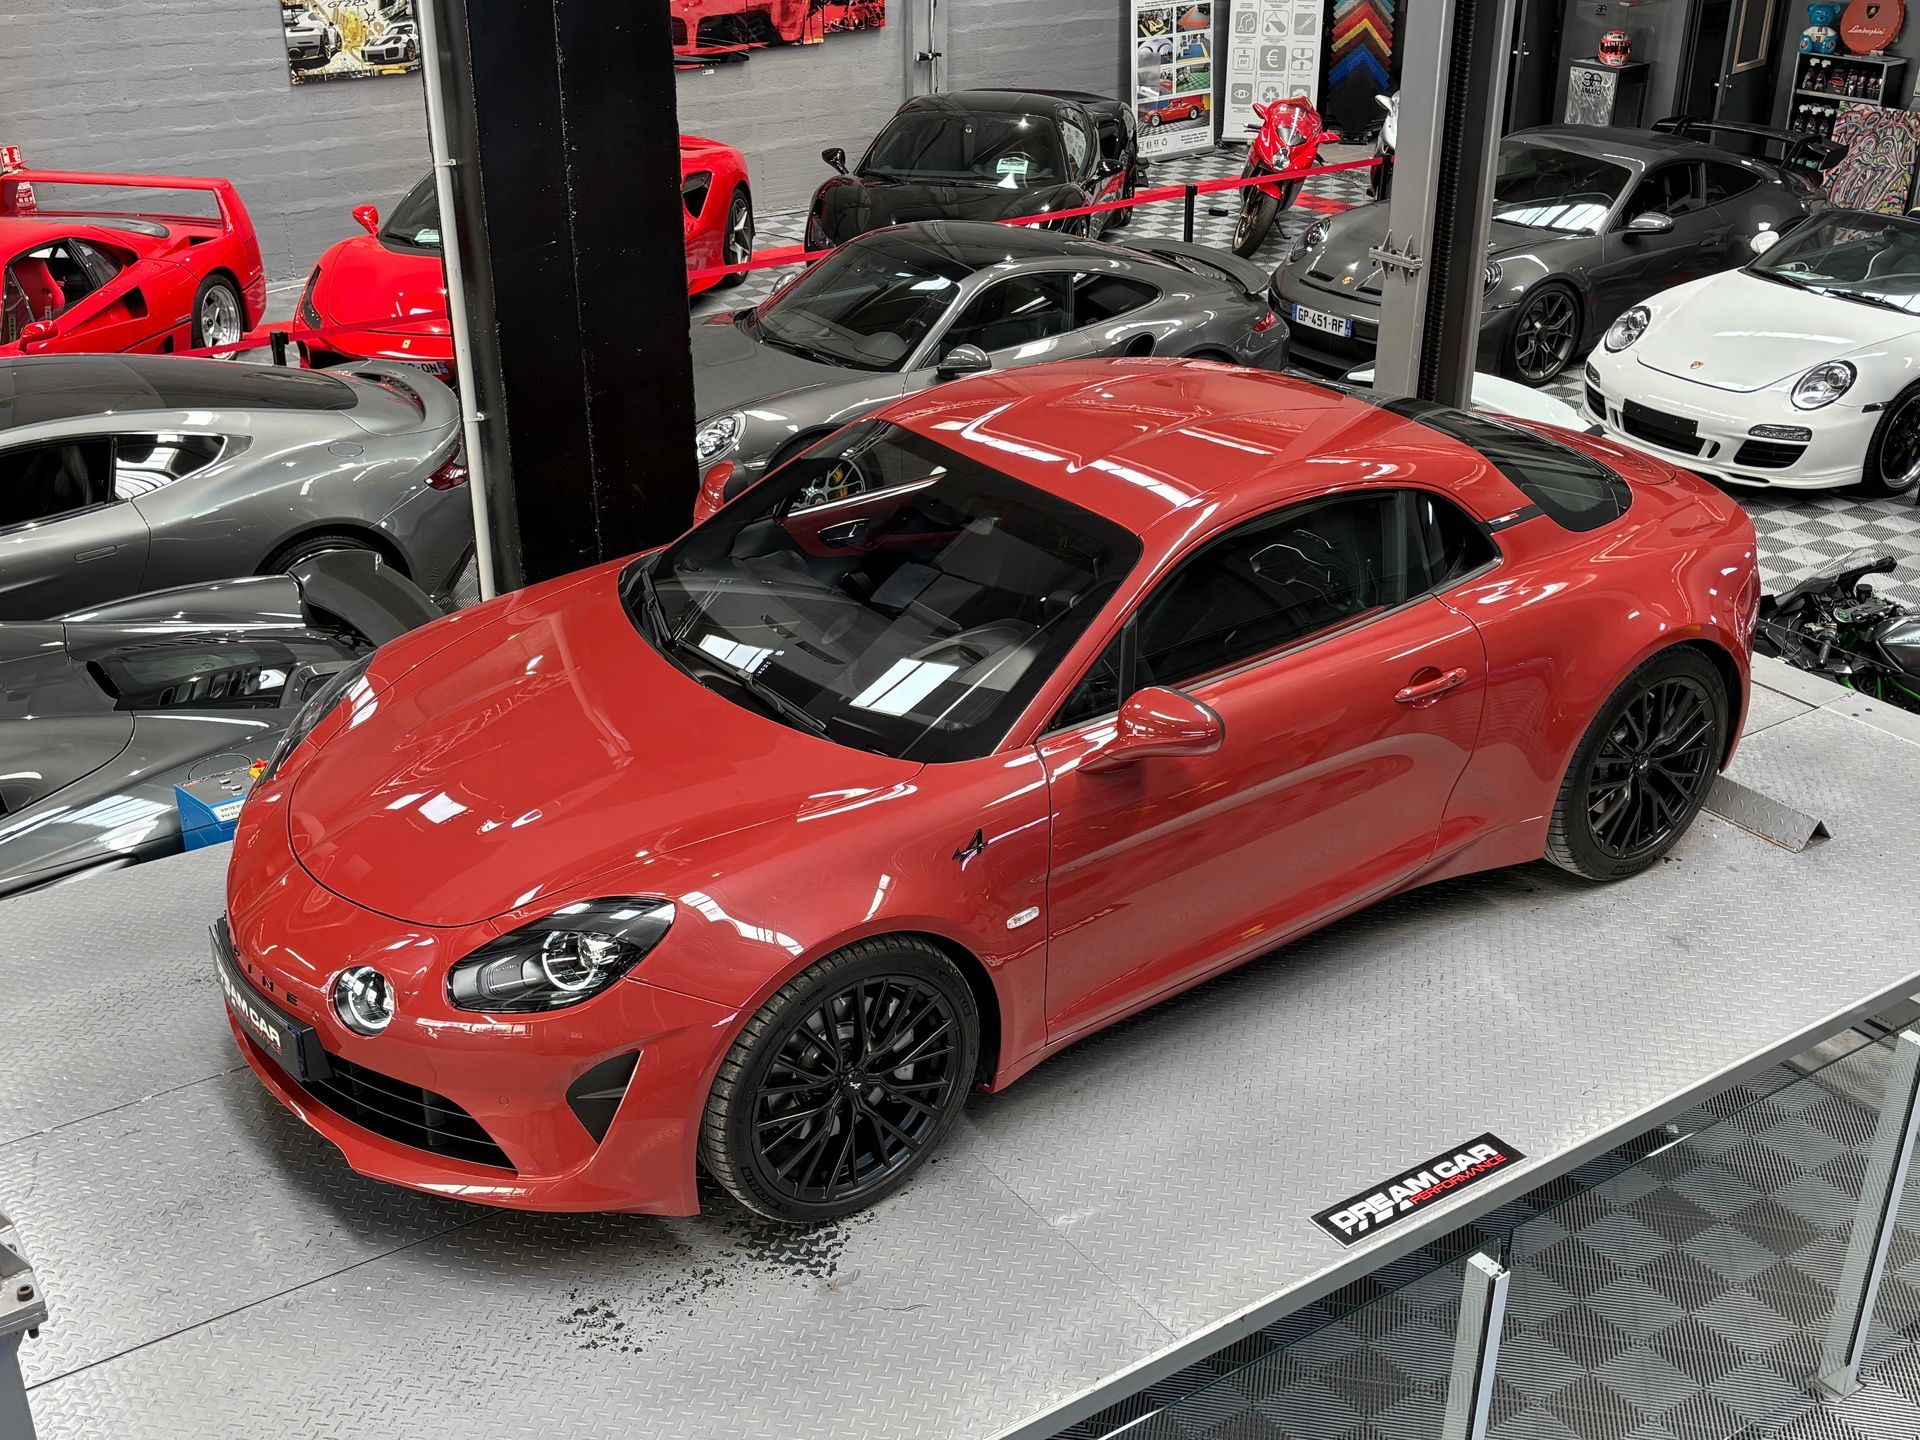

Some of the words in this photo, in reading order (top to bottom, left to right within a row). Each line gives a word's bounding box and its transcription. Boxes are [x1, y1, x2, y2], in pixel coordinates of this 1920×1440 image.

[1298, 307, 1345, 332] GP-451-RF
[249, 1007, 281, 1048] CAR
[1328, 1170, 1440, 1235] DREAM
[1433, 1143, 1498, 1178] CAR
[1410, 1153, 1507, 1205] PERFORMANCE
